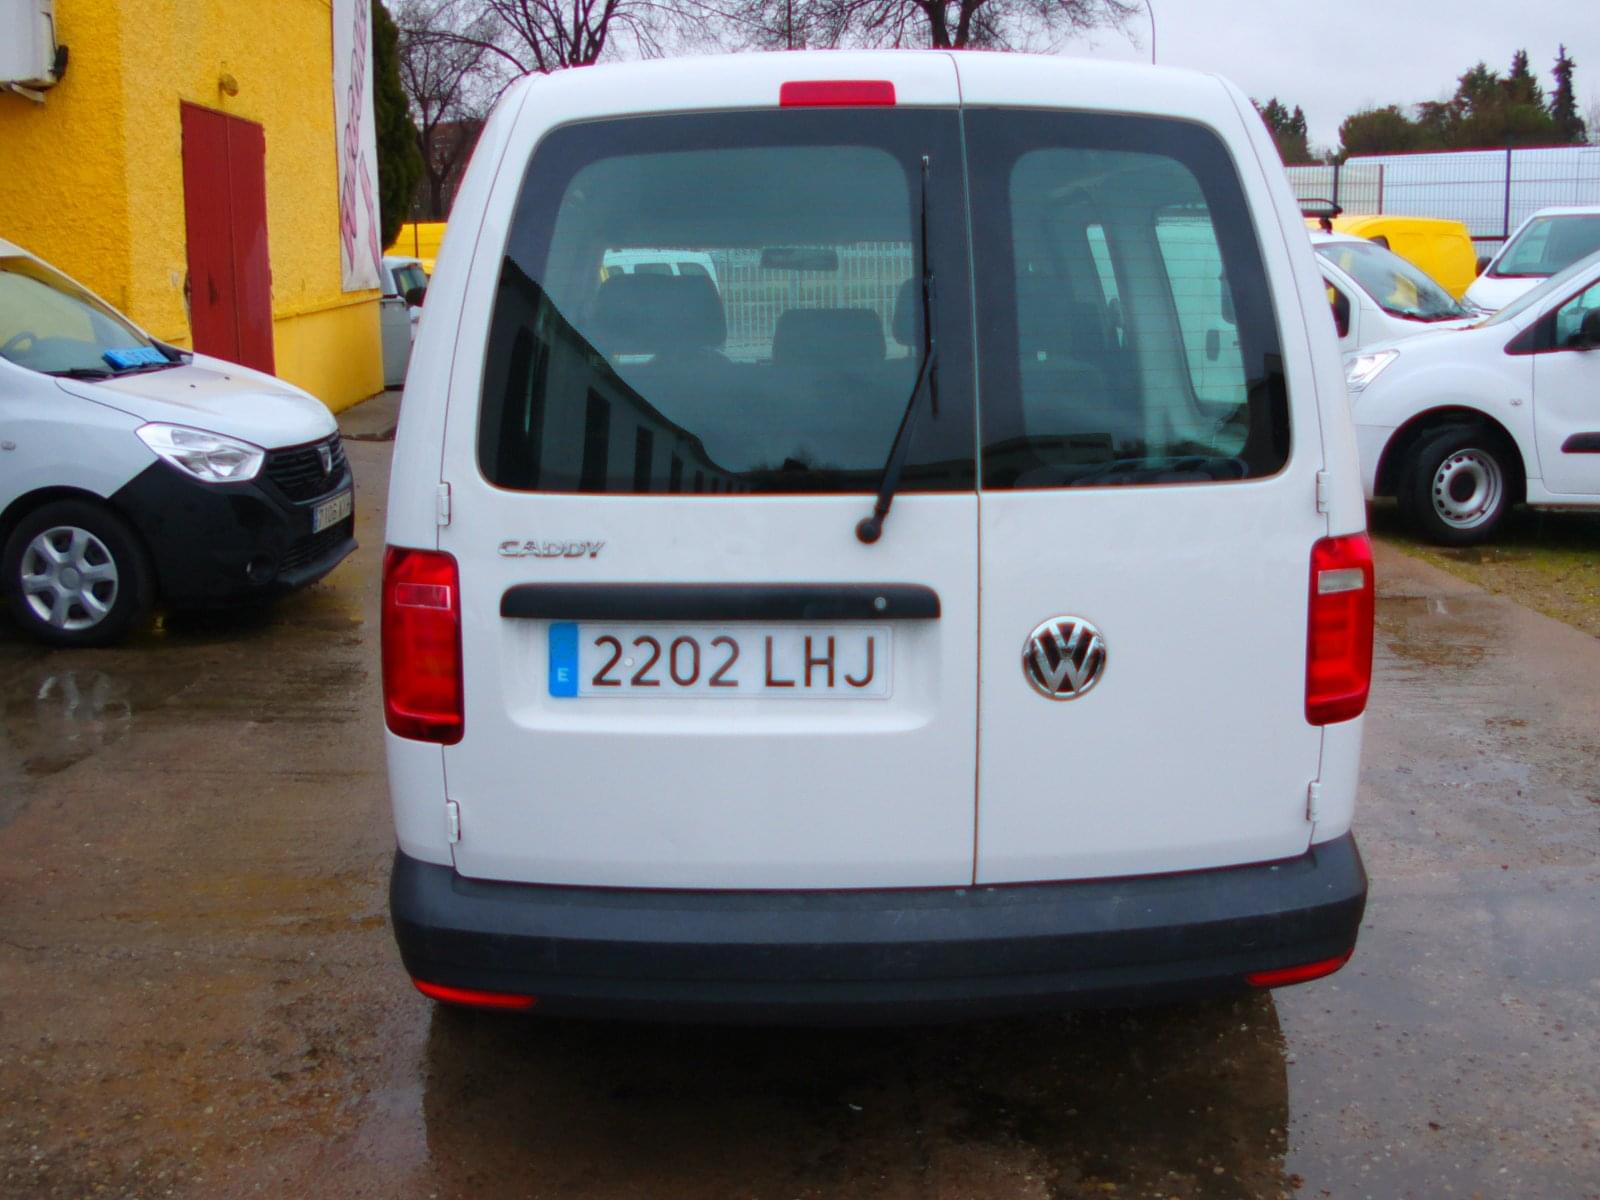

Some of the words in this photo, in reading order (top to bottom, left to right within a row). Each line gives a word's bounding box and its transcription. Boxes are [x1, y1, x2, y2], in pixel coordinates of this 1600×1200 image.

[498, 540, 606, 558] CADDY
[592, 635, 740, 687] 2202
[765, 635, 875, 688] LHJ
[557, 667, 569, 682] E
